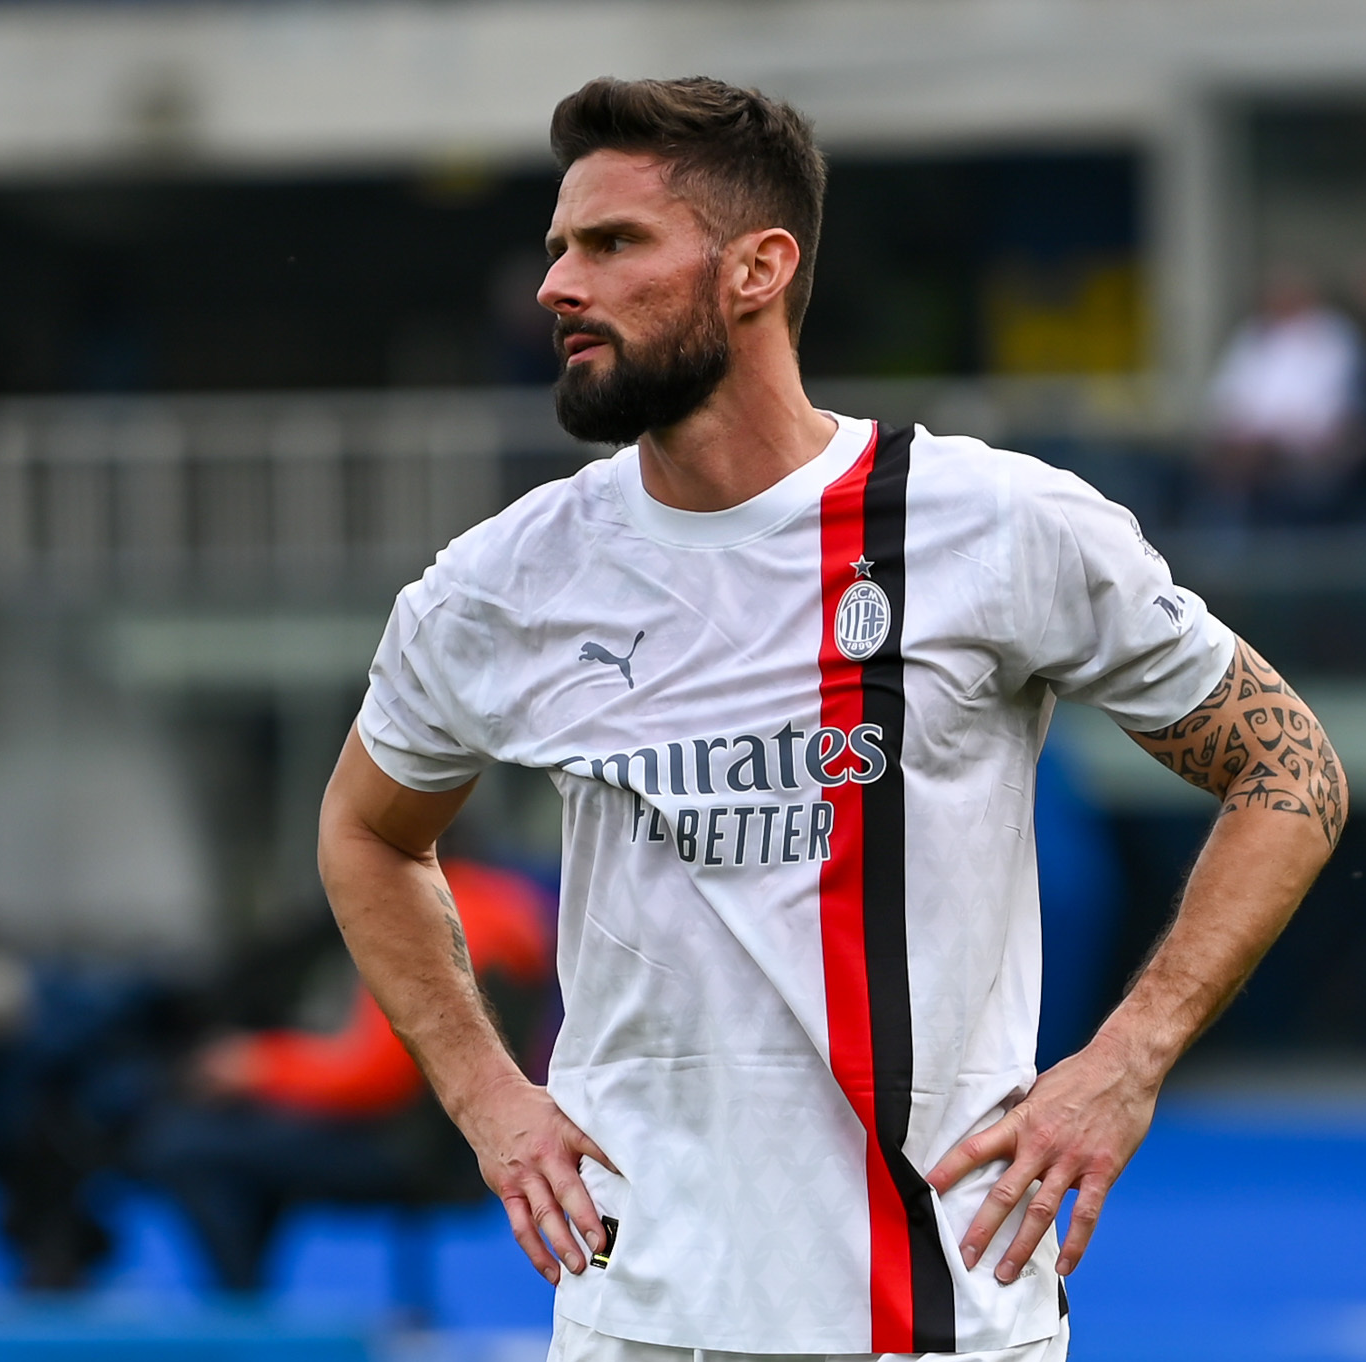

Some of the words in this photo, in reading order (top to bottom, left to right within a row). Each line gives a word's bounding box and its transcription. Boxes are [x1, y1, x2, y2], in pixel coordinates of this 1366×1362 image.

[847, 587, 879, 605] ACM
[846, 641, 873, 651] 1899
[554, 720, 886, 795] mirates
[677, 802, 834, 866] BETTER
